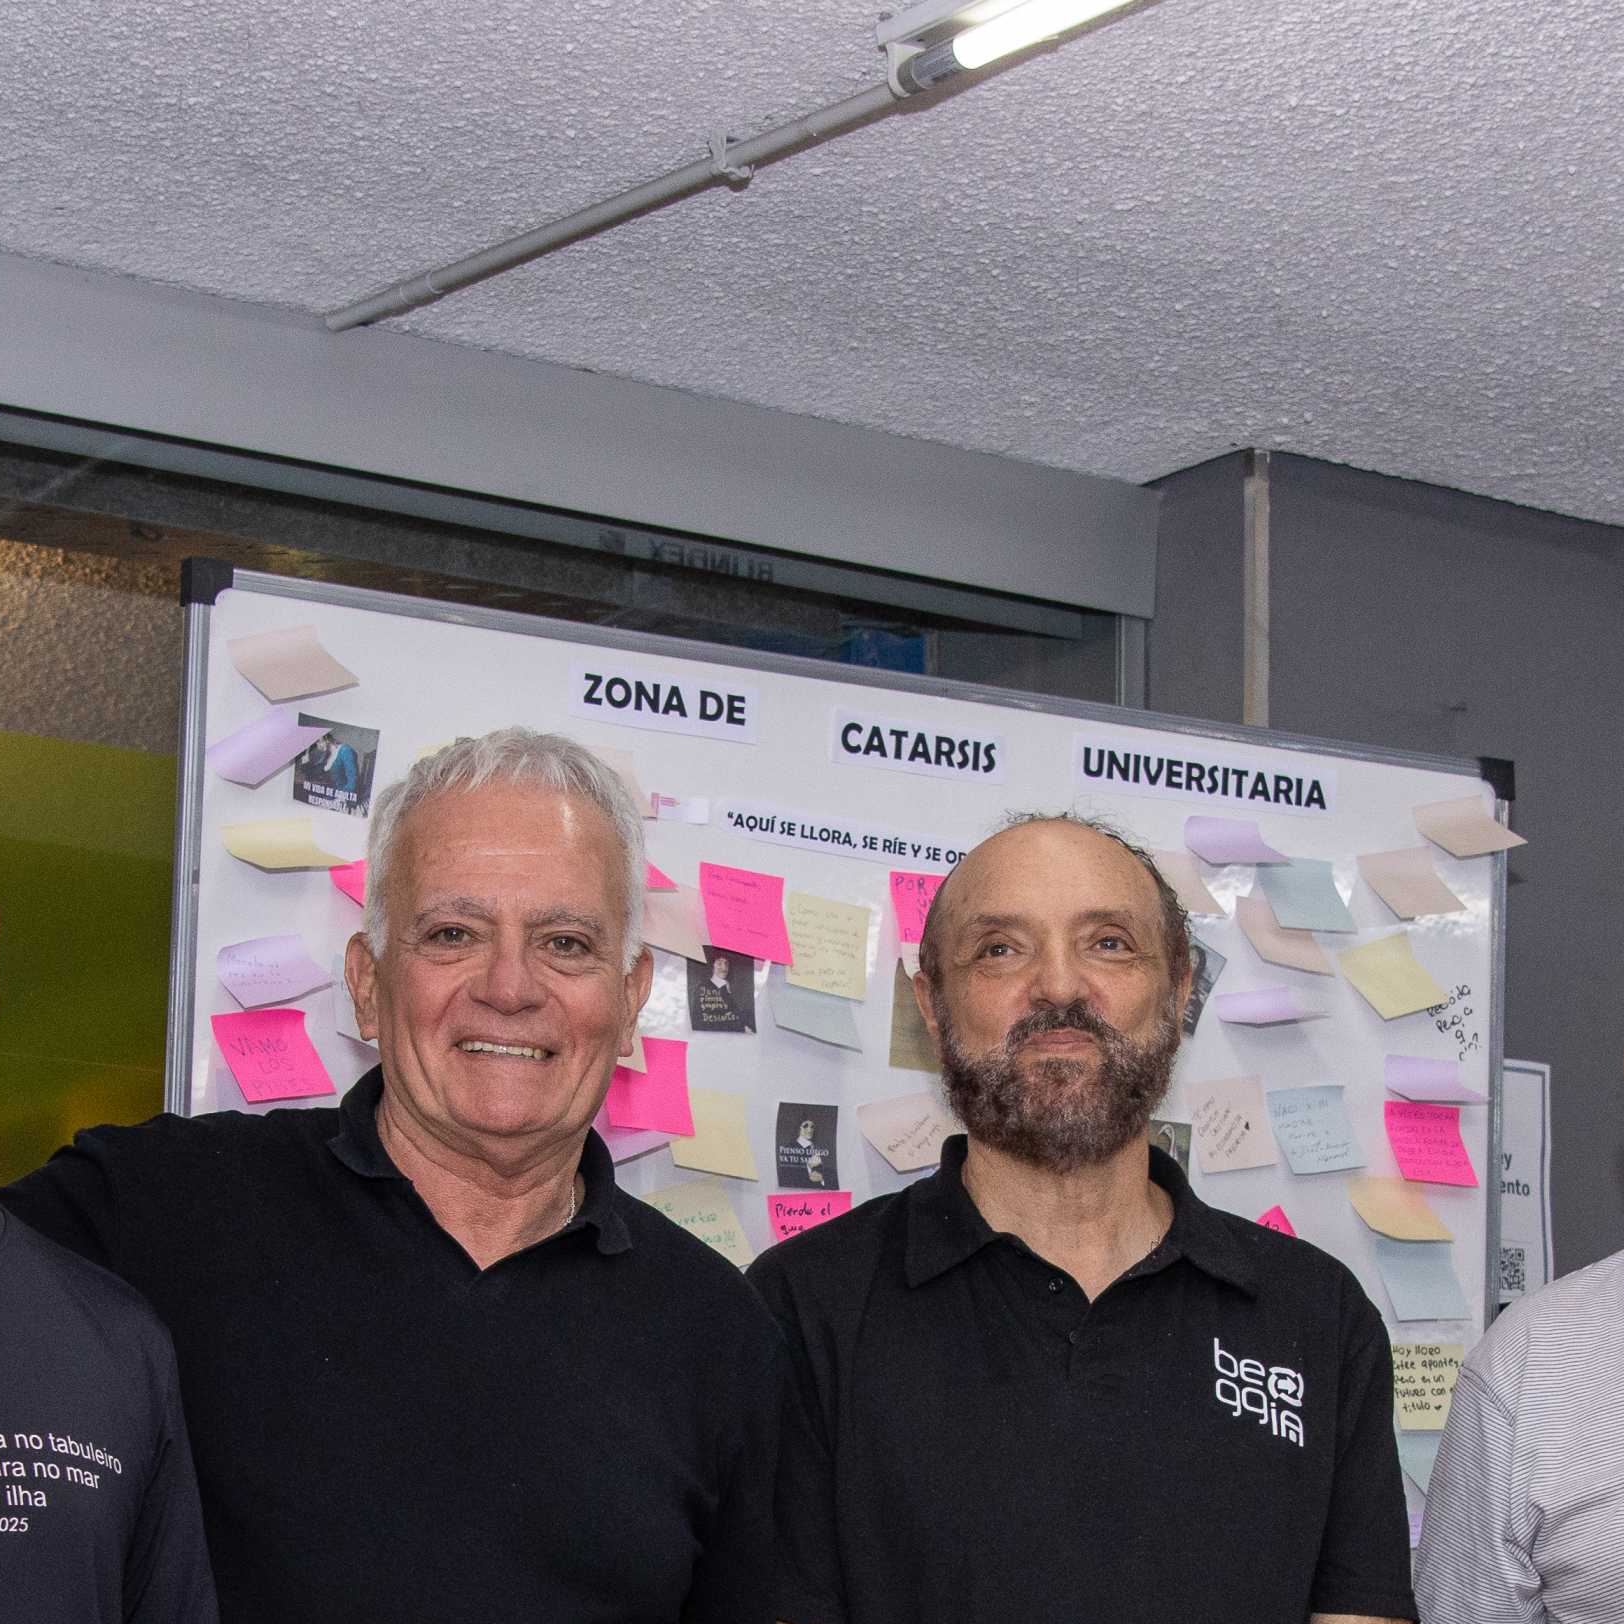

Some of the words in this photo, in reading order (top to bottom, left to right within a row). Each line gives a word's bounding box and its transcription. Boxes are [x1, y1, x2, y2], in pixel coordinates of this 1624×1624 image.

[583, 673, 688, 718] ZONA
[699, 690, 746, 726] DE
[841, 722, 997, 774] CATARSIS
[1083, 747, 1327, 810] UNIVERSITARIA
[779, 820, 796, 837] SE
[800, 824, 857, 849] LLORA,
[862, 835, 878, 851] SE
[882, 837, 907, 856] RÍE
[911, 844, 922, 858] Y
[925, 846, 942, 864] SE
[15, 1433, 43, 1450] no
[48, 1433, 123, 1475] tabuleiro
[34, 1461, 60, 1479] no
[66, 1467, 99, 1489] mar
[6, 1485, 47, 1507] ilha
